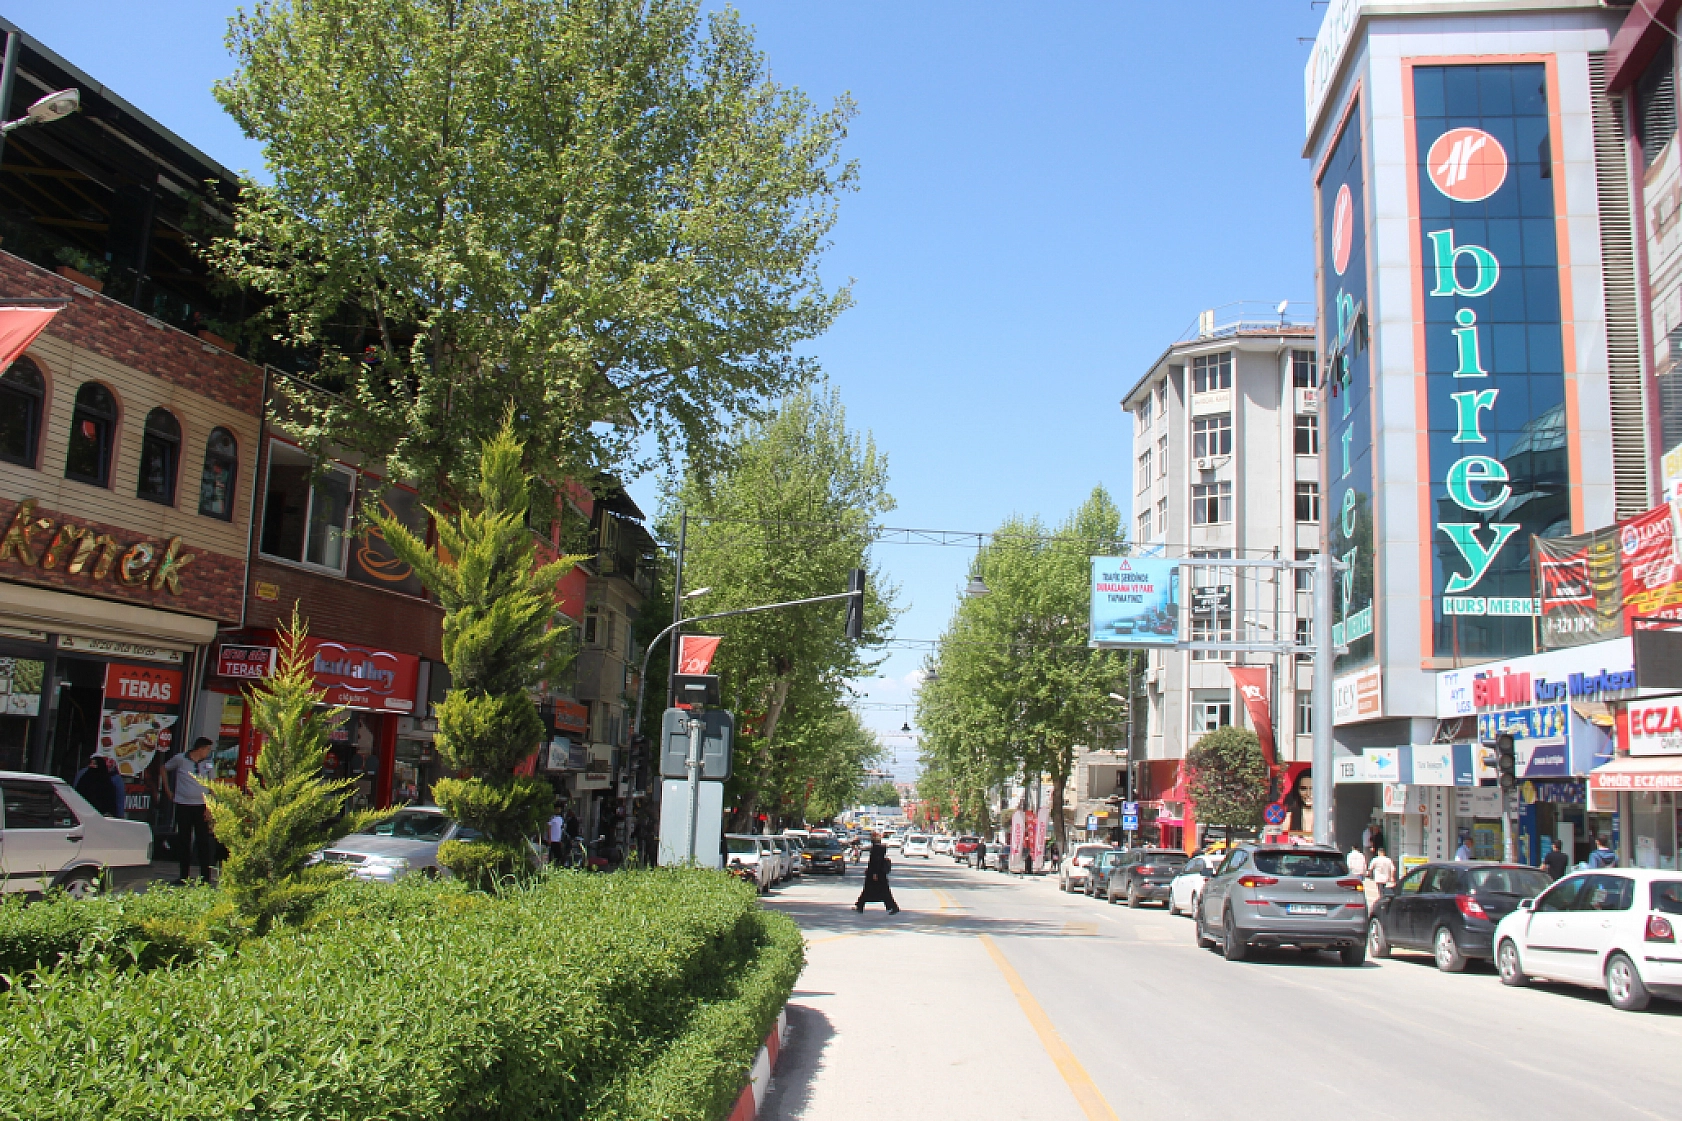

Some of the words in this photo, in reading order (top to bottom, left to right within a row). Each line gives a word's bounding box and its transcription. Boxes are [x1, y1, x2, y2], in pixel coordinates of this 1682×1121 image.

[1427, 228, 1521, 594] birey
[225, 661, 264, 675] TERAS
[119, 677, 172, 700] TERAS
[1535, 678, 1567, 700] Kurs
[1340, 763, 1355, 776] TEB
[1599, 773, 1631, 787] ÖMÜR
